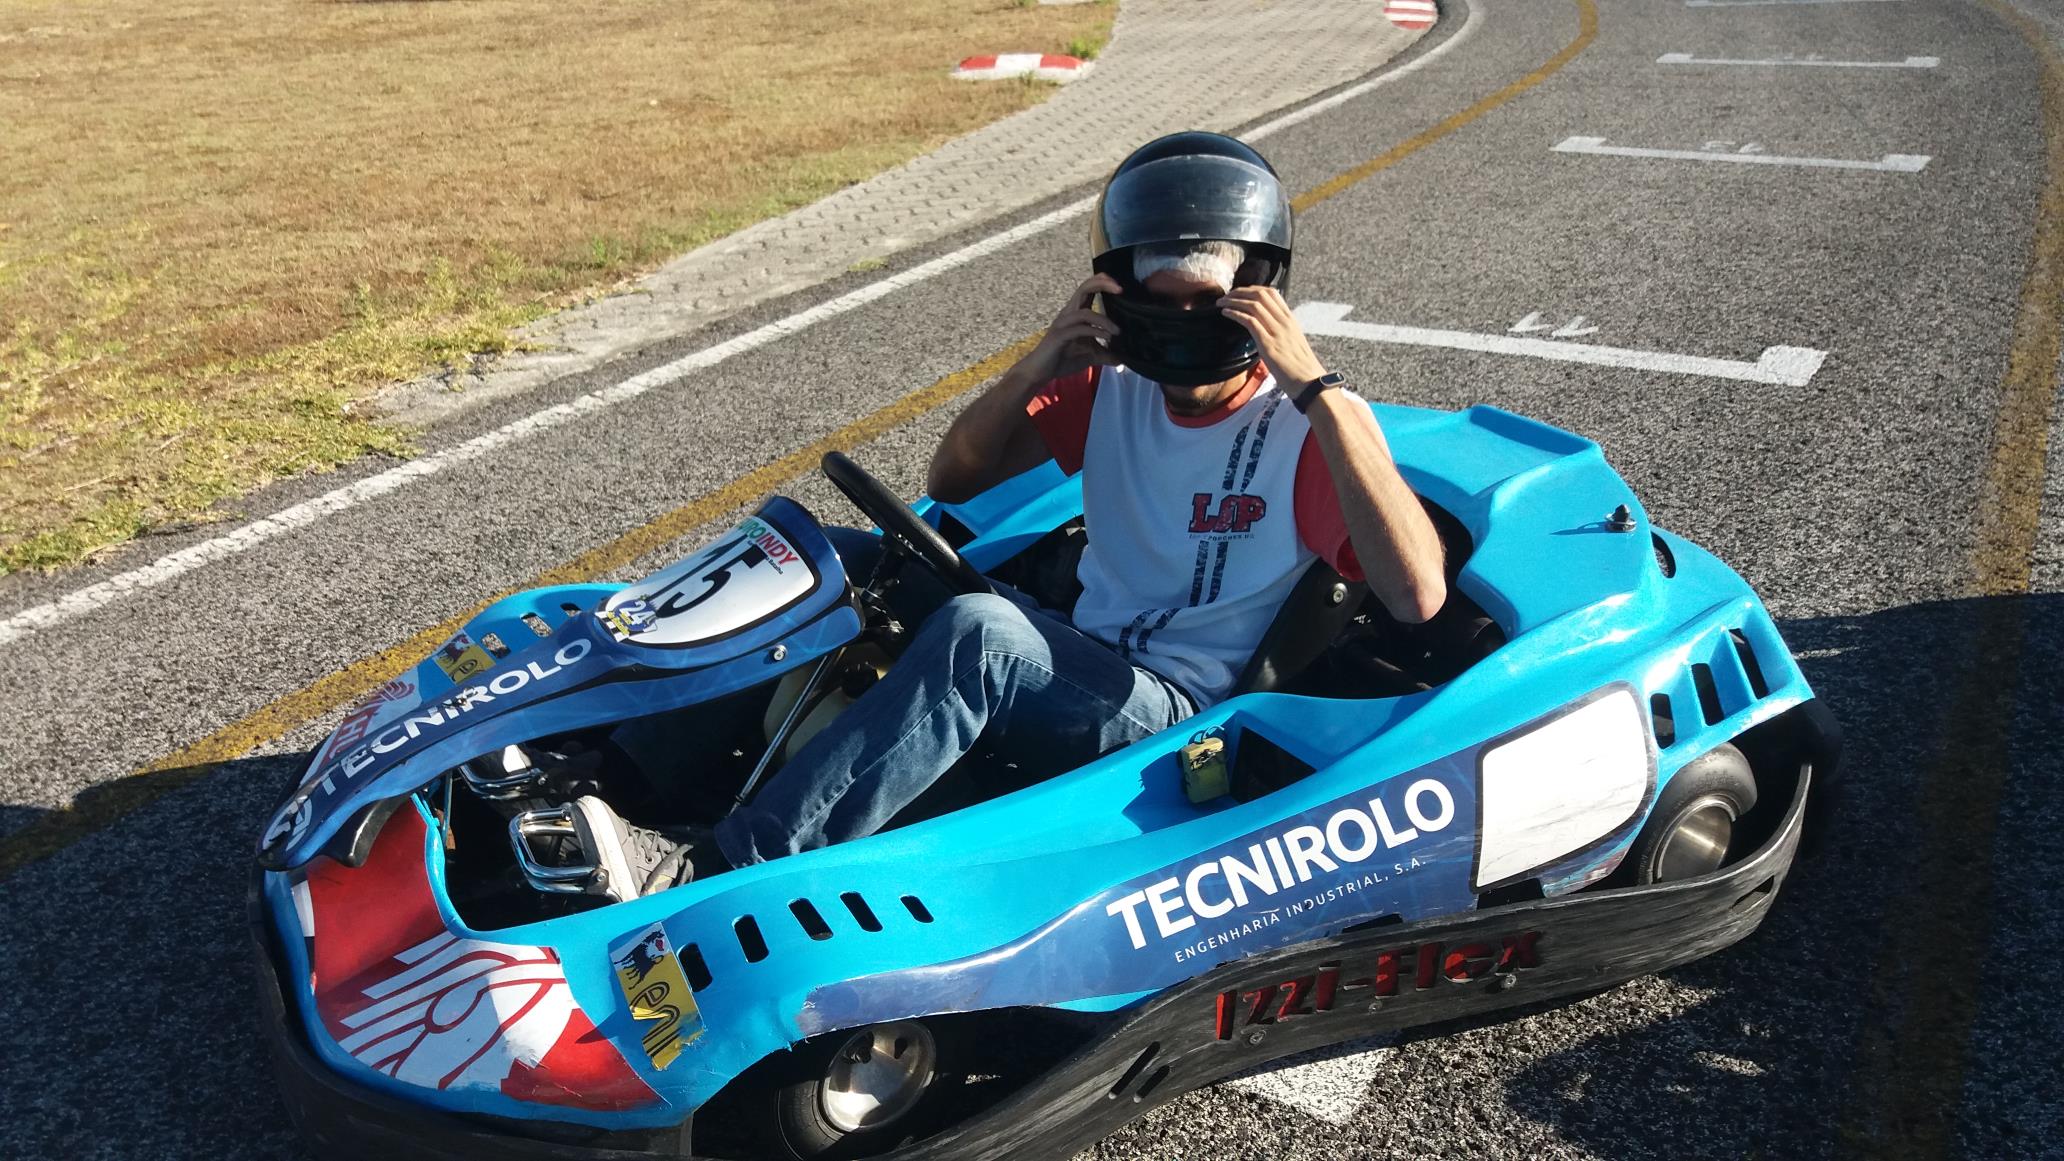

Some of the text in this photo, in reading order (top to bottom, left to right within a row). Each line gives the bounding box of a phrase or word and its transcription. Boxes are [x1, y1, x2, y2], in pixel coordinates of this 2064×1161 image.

[645, 533, 768, 618] 15
[737, 517, 799, 565] ROINDY
[317, 638, 592, 795] TECNIROLO
[1106, 778, 1455, 950] TECNIROLO
[1174, 858, 1427, 963] ENGENHARIA INDUSTRIAL, S.A.
